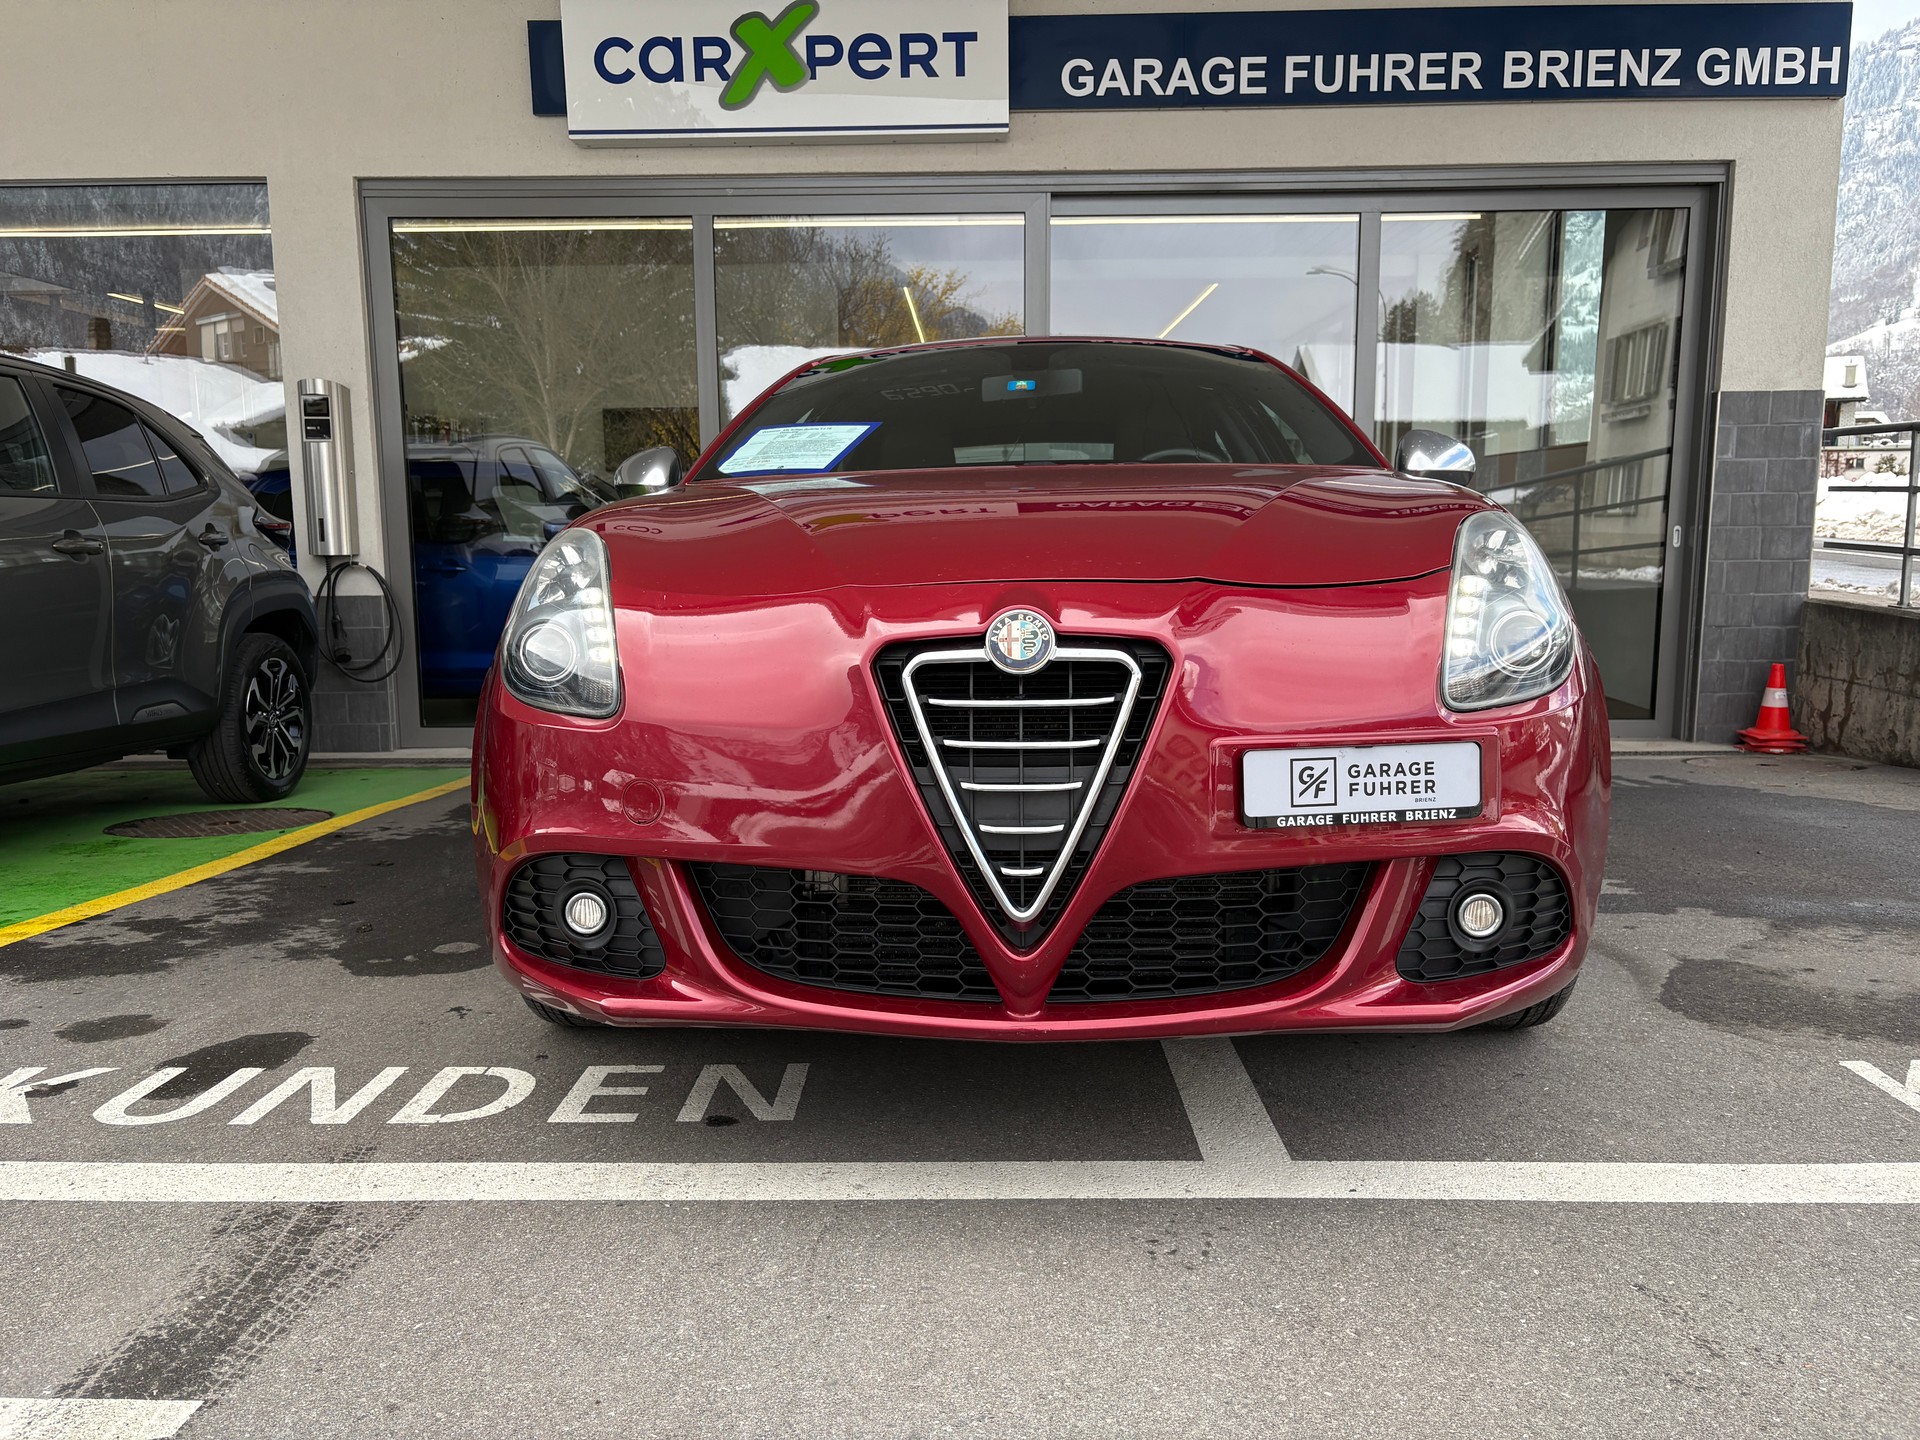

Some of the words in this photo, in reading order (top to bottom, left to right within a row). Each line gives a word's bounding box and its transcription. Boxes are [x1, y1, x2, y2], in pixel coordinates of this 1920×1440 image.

[1061, 56, 1267, 96] GARAGE
[1285, 52, 1483, 93] FUHRER
[1503, 48, 1681, 89] BRIENZ
[1696, 45, 1841, 87] GMBH
[991, 617, 1012, 642] ALFA
[1018, 614, 1049, 641] ROMEO
[1347, 761, 1435, 779] GARAGE
[1349, 780, 1436, 797] FUHRER
[1277, 814, 1334, 827] GARAGE
[1342, 811, 1397, 824] FUHRER
[1405, 808, 1457, 821] BRIENZ
[0, 1063, 811, 1126] KUNDEN
